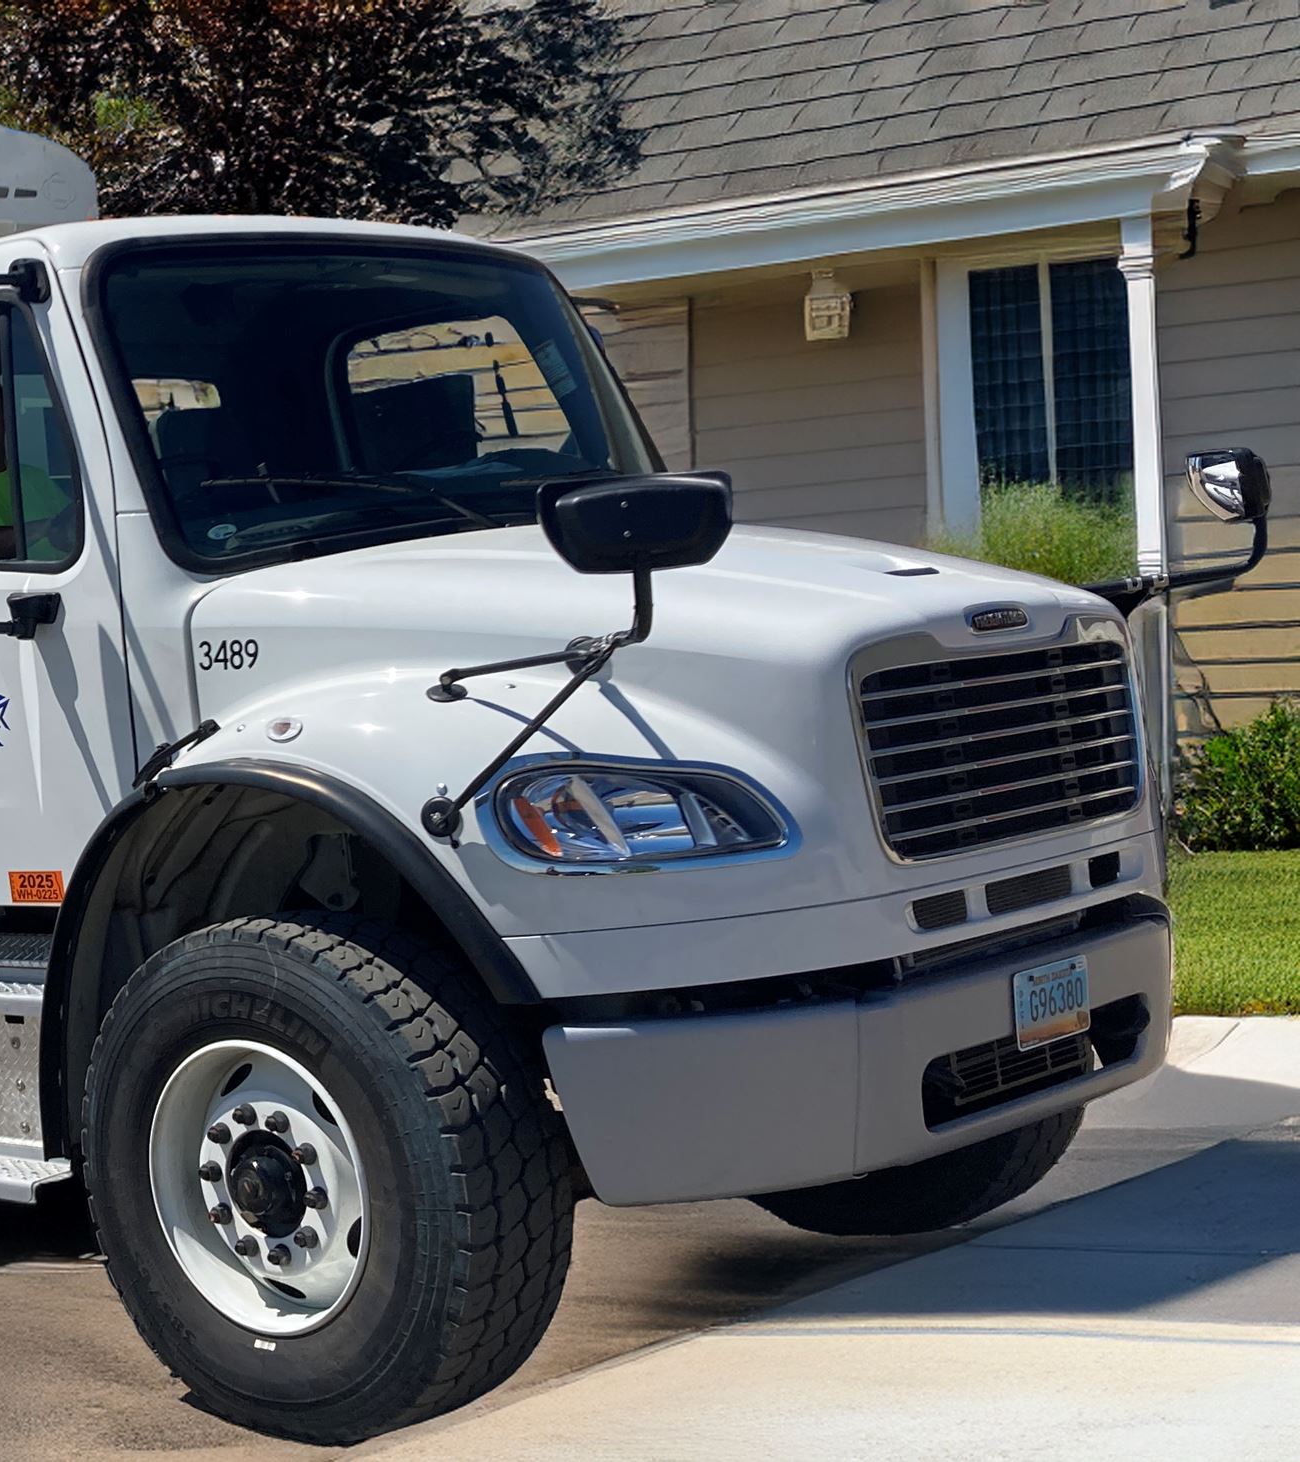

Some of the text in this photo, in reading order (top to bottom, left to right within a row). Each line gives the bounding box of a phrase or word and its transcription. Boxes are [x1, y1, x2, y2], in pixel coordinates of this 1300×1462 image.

[198, 638, 259, 671] 3489
[18, 874, 54, 889] 2025
[16, 888, 59, 900] WH-0225
[1029, 976, 1084, 1022] G96380
